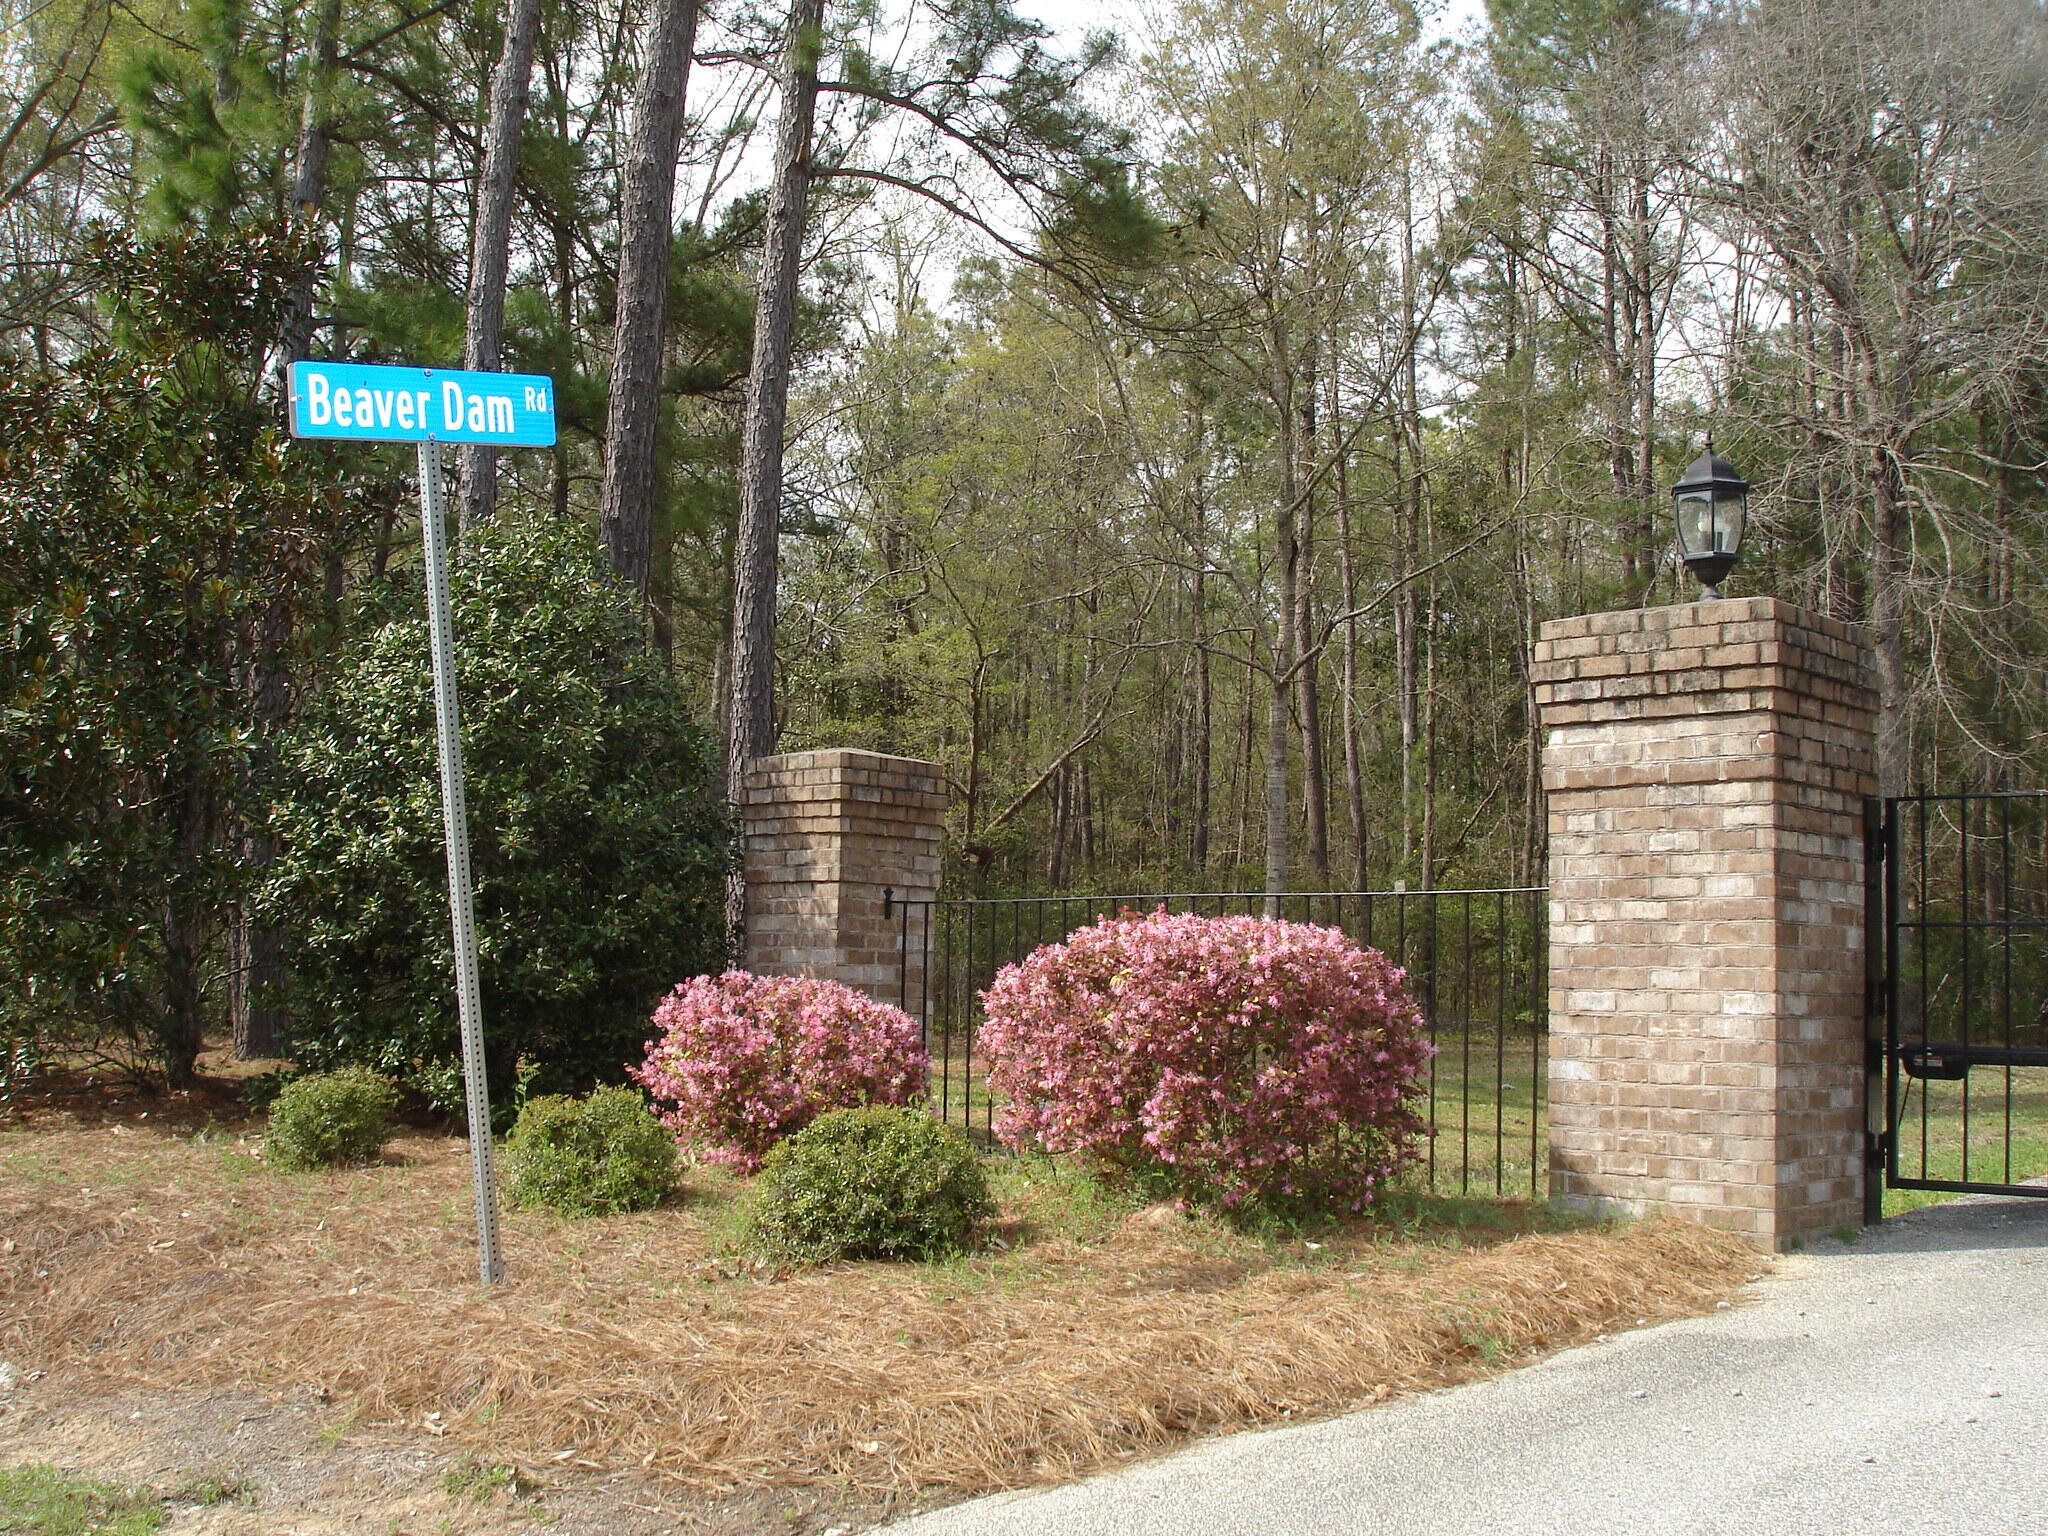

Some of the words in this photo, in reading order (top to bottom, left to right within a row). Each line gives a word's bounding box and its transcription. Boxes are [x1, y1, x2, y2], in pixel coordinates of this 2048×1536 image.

[307, 373, 431, 430] Beaver
[442, 381, 515, 433] Dam
[524, 386, 547, 412] Rd
